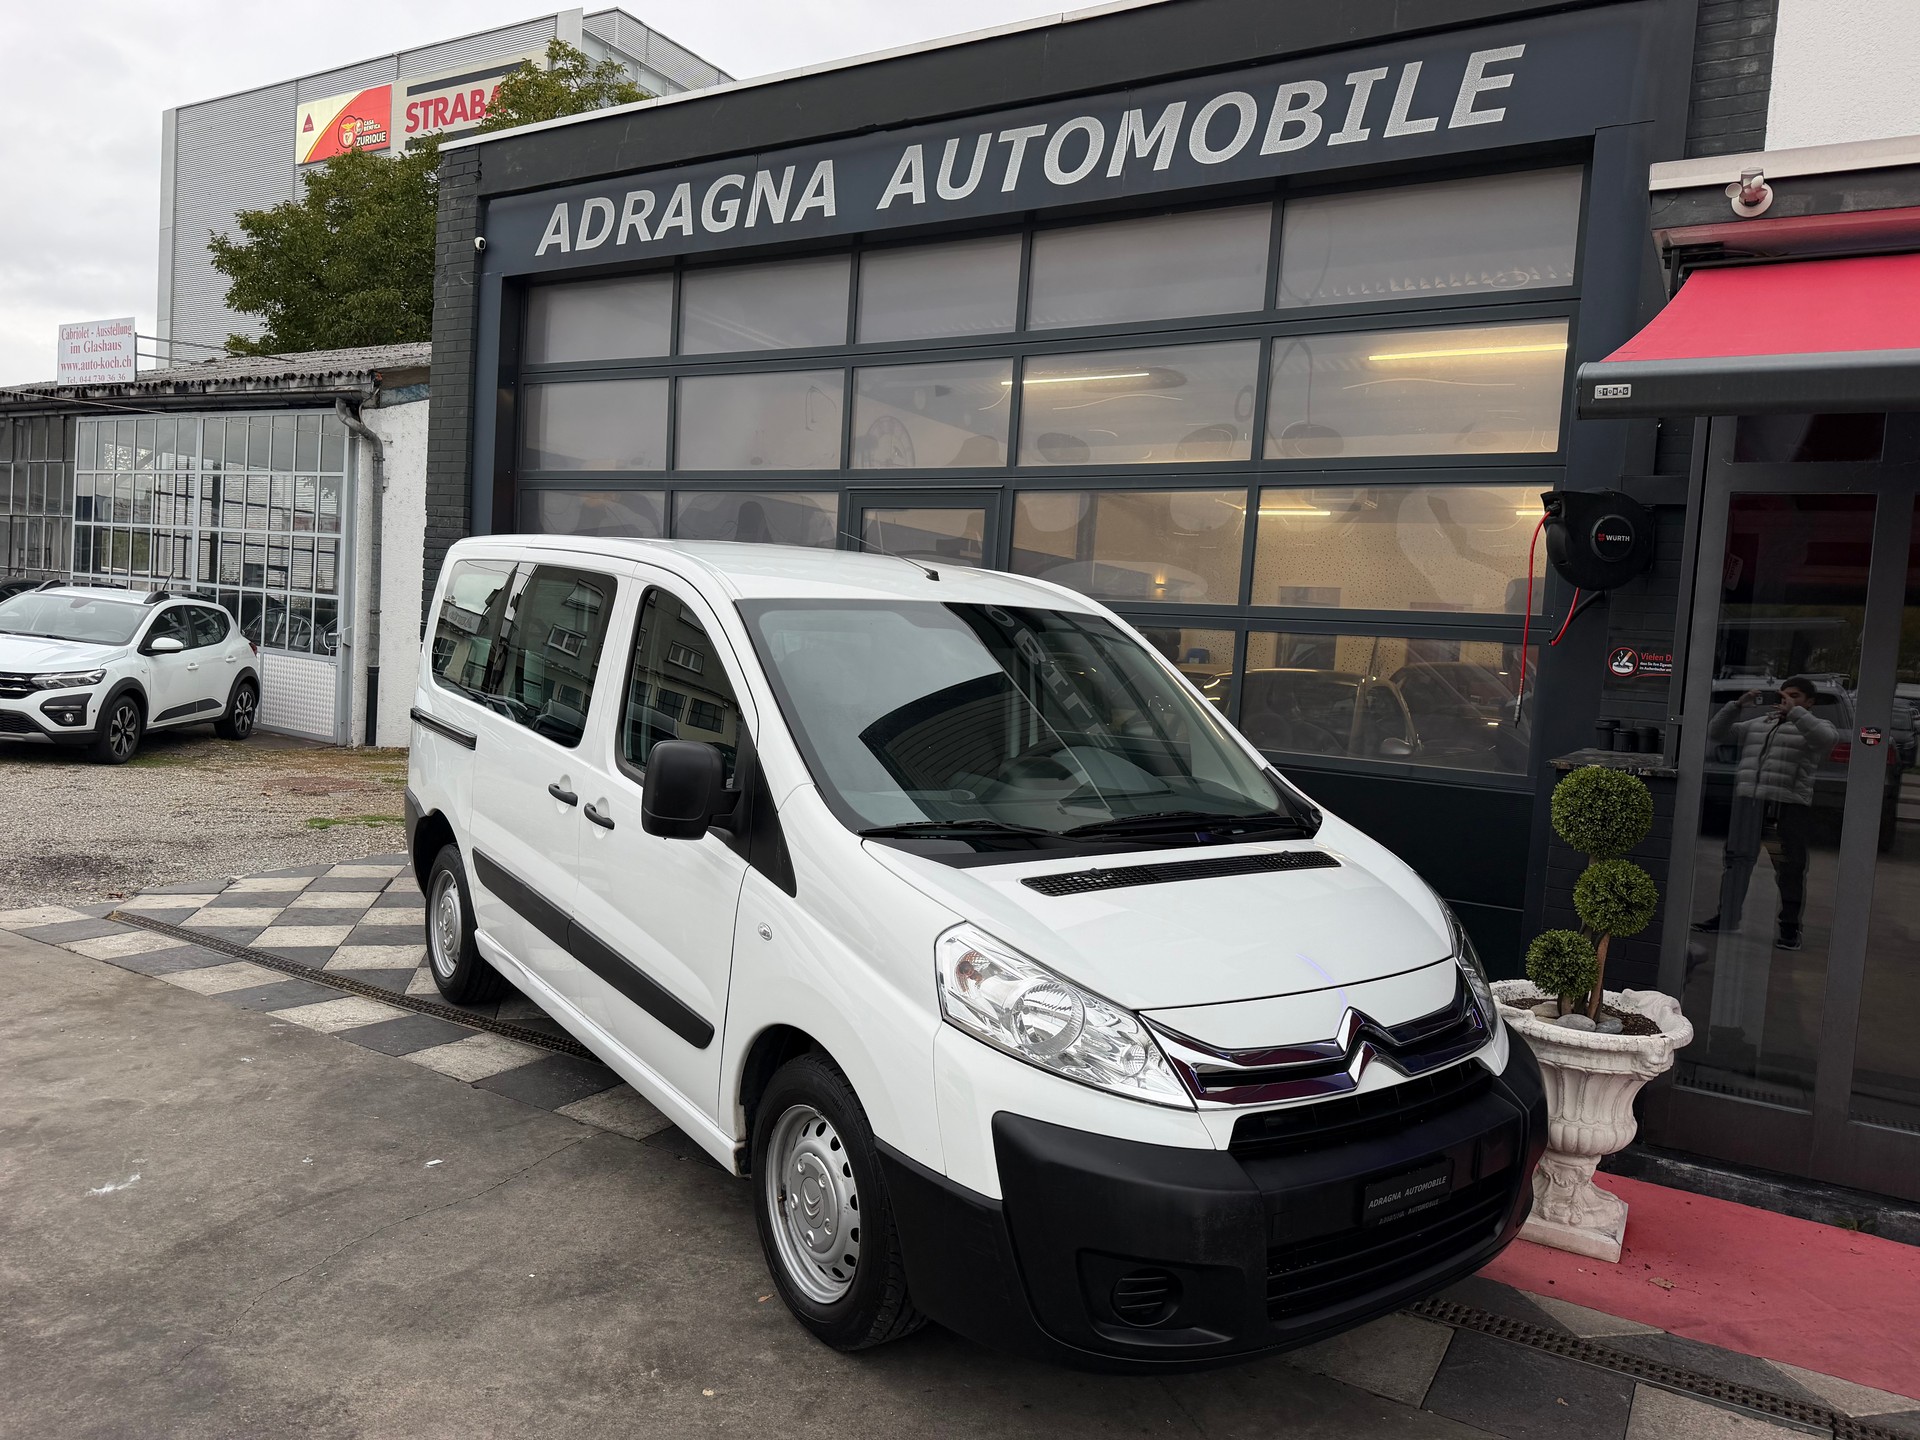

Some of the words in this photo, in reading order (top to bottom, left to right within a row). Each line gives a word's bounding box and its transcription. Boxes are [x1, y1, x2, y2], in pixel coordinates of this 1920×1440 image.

[356, 131, 387, 147] ZURIQUE
[534, 159, 837, 257] ADRAGNA
[876, 43, 1527, 210] AUTOMOBILE
[61, 326, 90, 341] Cabriolet
[96, 322, 132, 337] Ausstellung
[70, 341, 81, 354] im
[83, 339, 122, 354] Glashaus
[60, 354, 132, 372] www.auto-koch.ch
[80, 375, 92, 383] 044
[93, 374, 106, 382] 730
[118, 373, 126, 381] 36
[1640, 652, 1664, 661] Vielen
[1665, 654, 1673, 662] D
[1368, 1191, 1402, 1209] ADRAGNA
[1404, 1175, 1447, 1197] AUTOMOBILE
